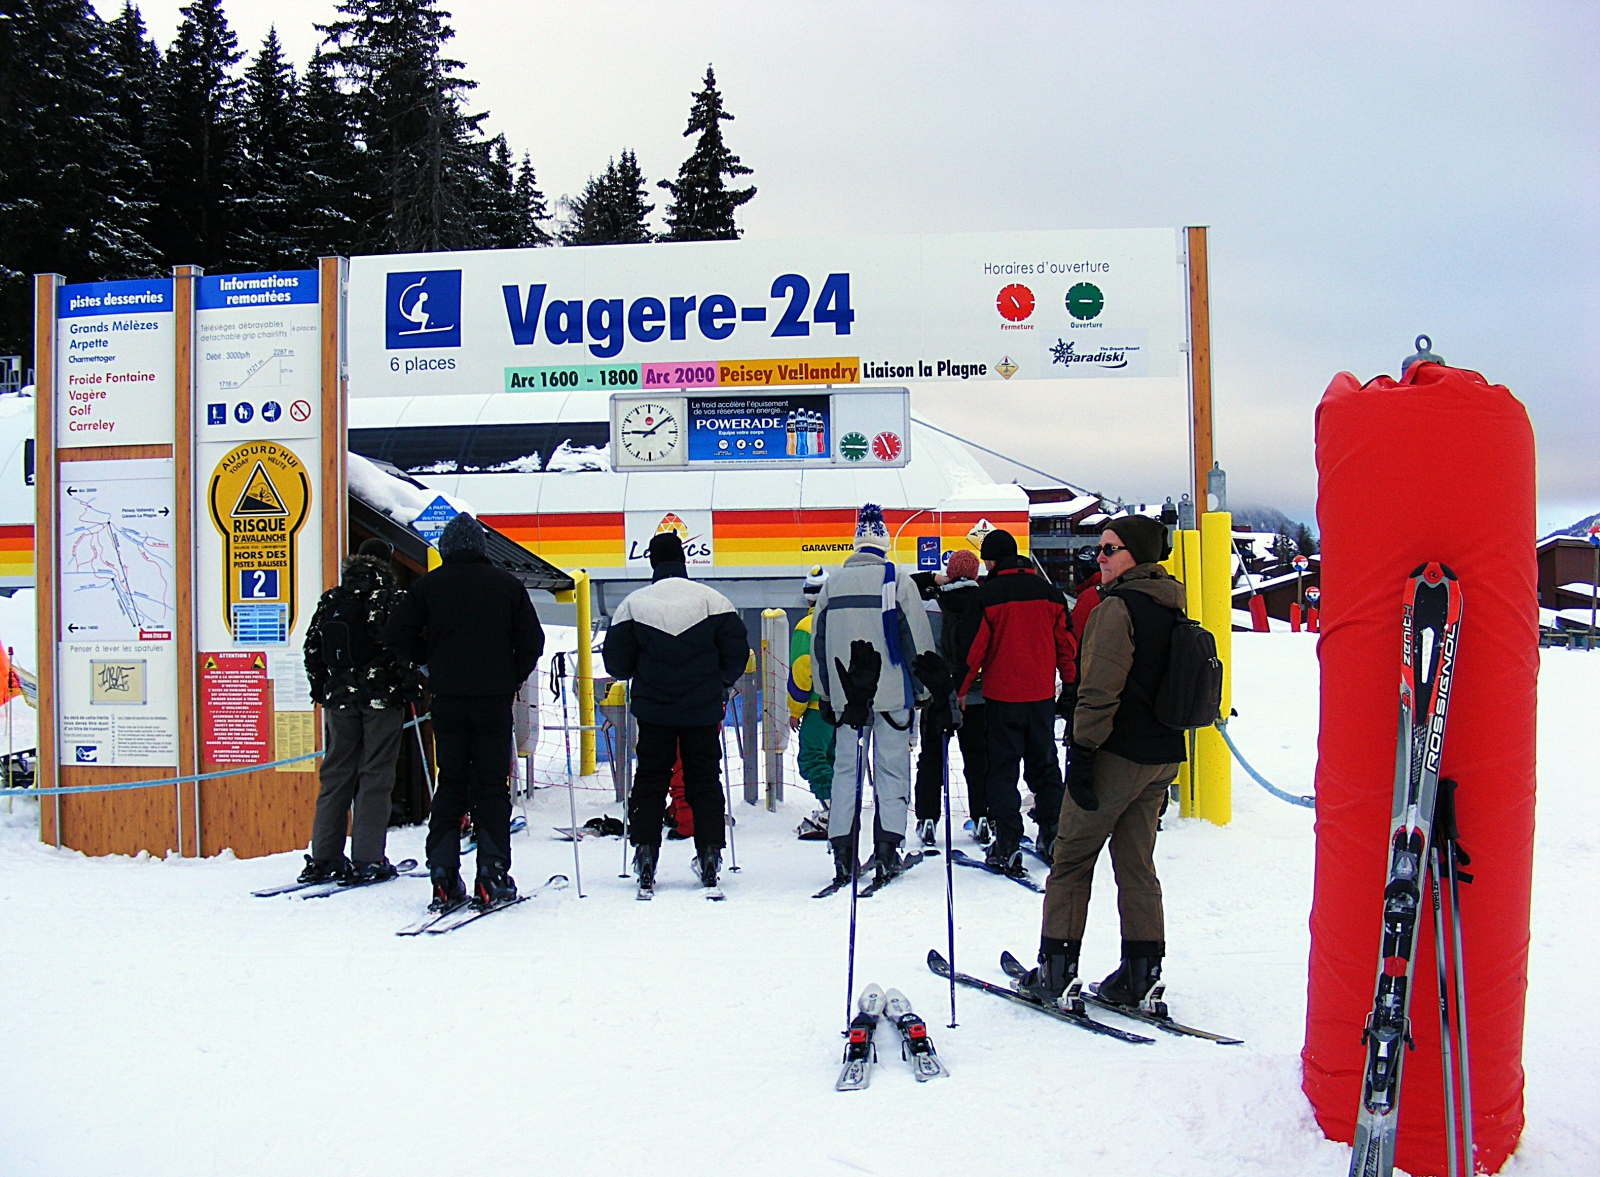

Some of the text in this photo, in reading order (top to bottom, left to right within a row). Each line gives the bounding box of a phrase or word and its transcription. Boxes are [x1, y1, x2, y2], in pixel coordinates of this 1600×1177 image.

[984, 261, 1110, 275] Horaires d'ouverture
[220, 274, 299, 291] Informations
[70, 291, 163, 310] pistes desservies
[226, 290, 292, 305] remontées
[502, 273, 855, 358] Vagere-24
[70, 320, 159, 334] Grands Mélèzes
[201, 321, 284, 332] Télésièges débrayables
[200, 331, 287, 342] detachable grip chairlifts
[69, 338, 109, 351] Arpette
[68, 355, 116, 364] Charmettoger
[390, 356, 456, 374] 6 places
[1064, 352, 1124, 366] paradiski
[646, 366, 715, 384] Arc 2000
[720, 365, 773, 383] Peisey
[863, 359, 987, 380] Liaison la Plagne
[69, 371, 156, 385] Froide Fontaine
[511, 373, 535, 388] Arc
[540, 371, 579, 387] 1600
[599, 369, 638, 386] 1800
[69, 389, 107, 402] Vagère
[69, 404, 92, 416] Golf
[746, 400, 789, 409] l'épuisement
[69, 420, 115, 432] Carreley
[222, 445, 298, 472] AUJOURD'HUI
[267, 456, 288, 471] HEUTE
[229, 457, 249, 475] TODAY
[234, 518, 286, 533] RISQUE
[234, 534, 286, 542] D'AVALANCHE
[234, 551, 263, 559] HORS
[802, 544, 855, 552] GARAVENTA
[253, 570, 266, 598] 2
[135, 645, 164, 653] spatules
[1426, 623, 1456, 773] ROSSIGNOL
